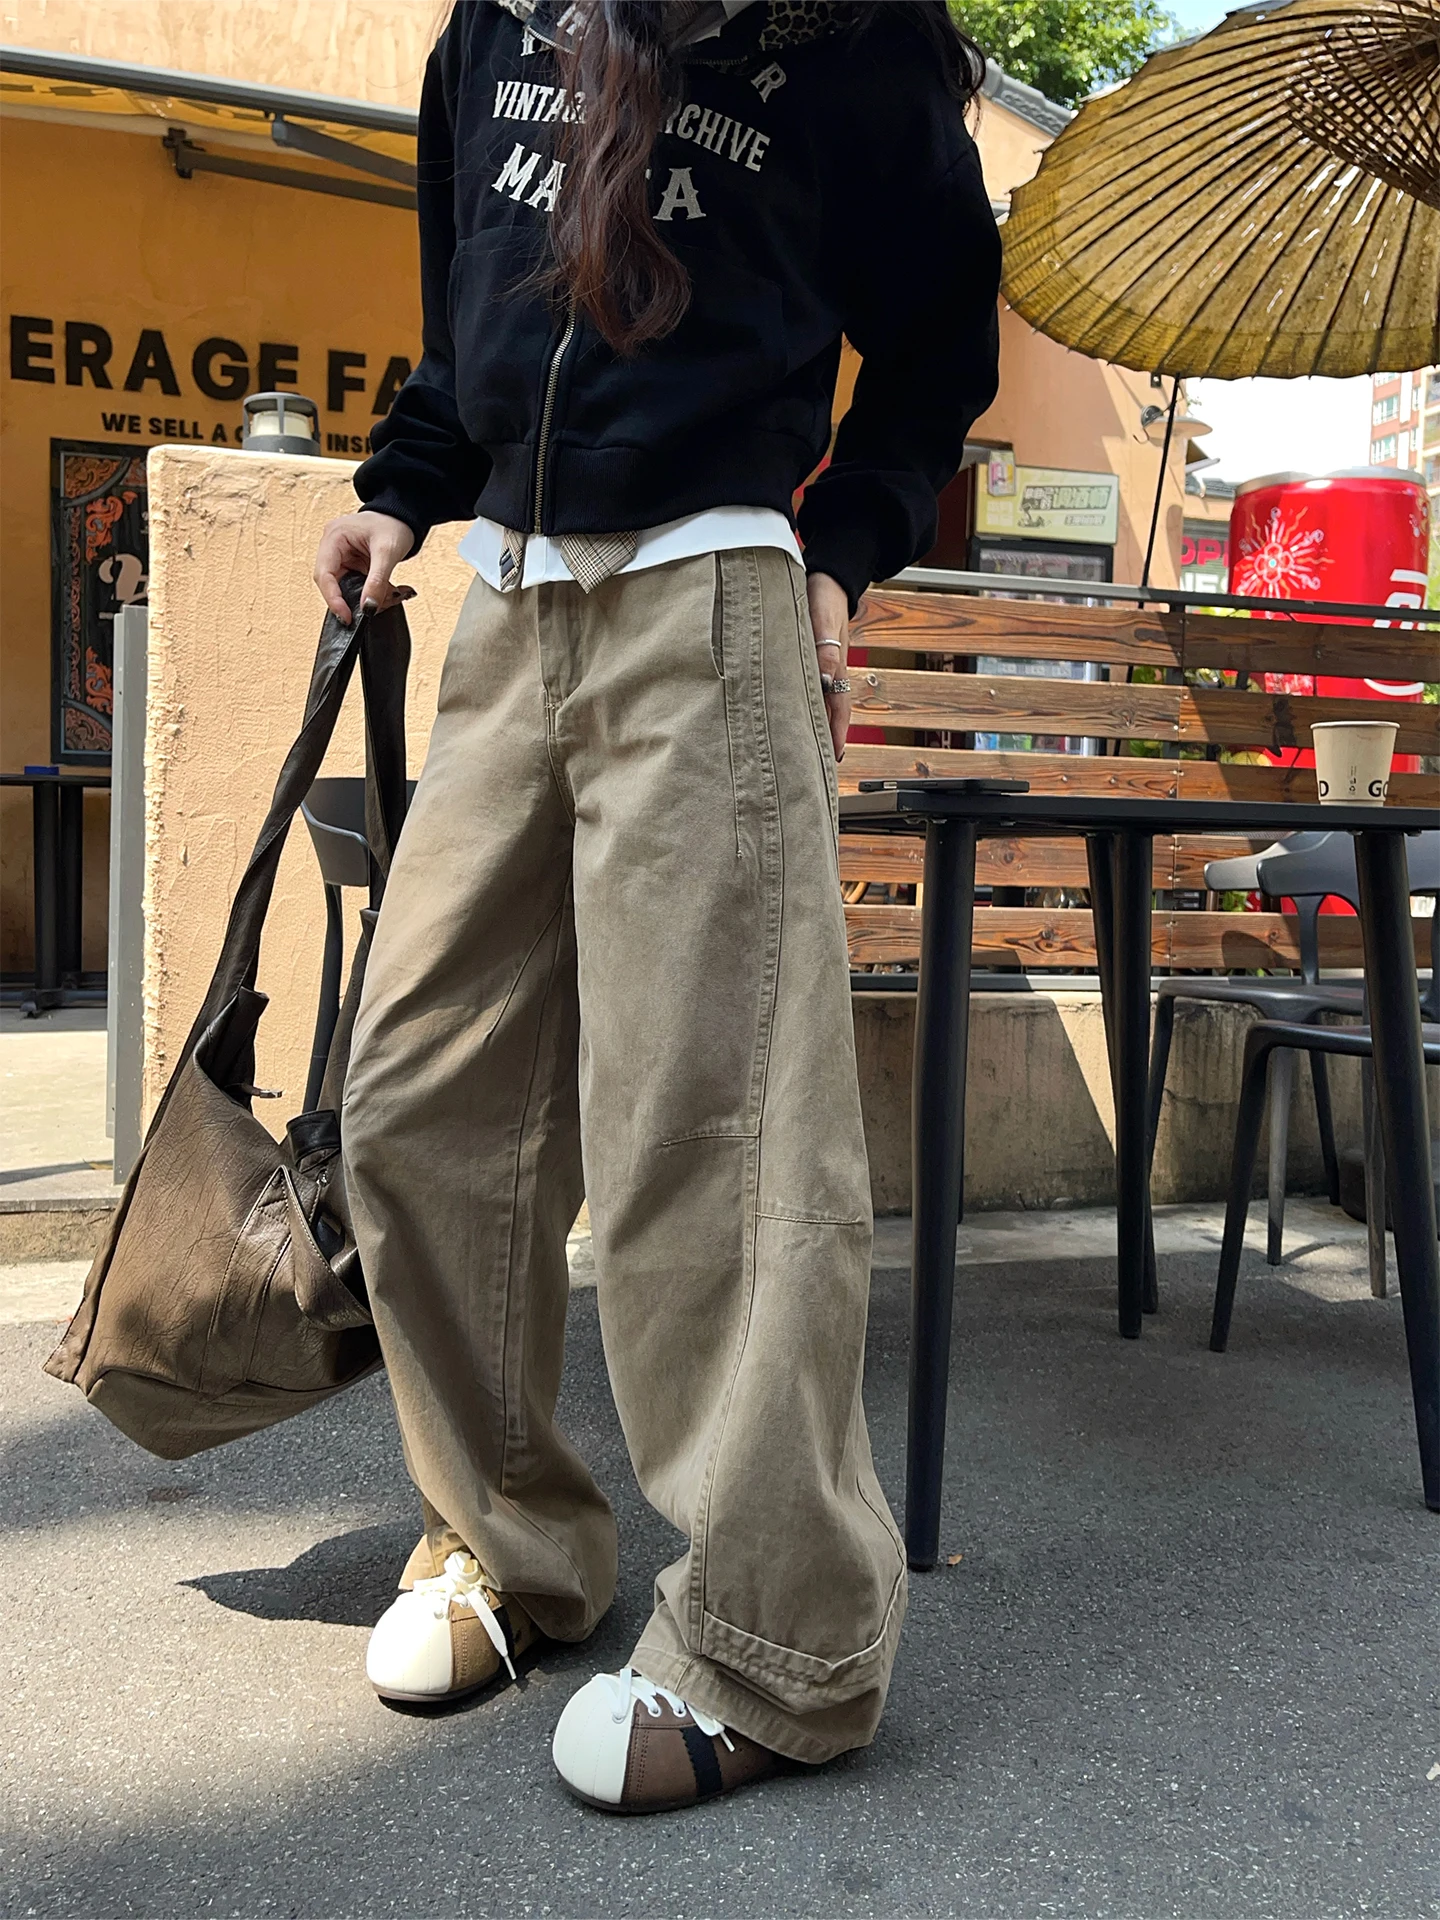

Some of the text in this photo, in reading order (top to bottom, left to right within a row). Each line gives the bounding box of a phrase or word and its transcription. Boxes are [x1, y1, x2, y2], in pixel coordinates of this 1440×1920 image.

[102, 413, 141, 434] WE
[149, 418, 204, 440] SELL
[211, 423, 228, 443] A
